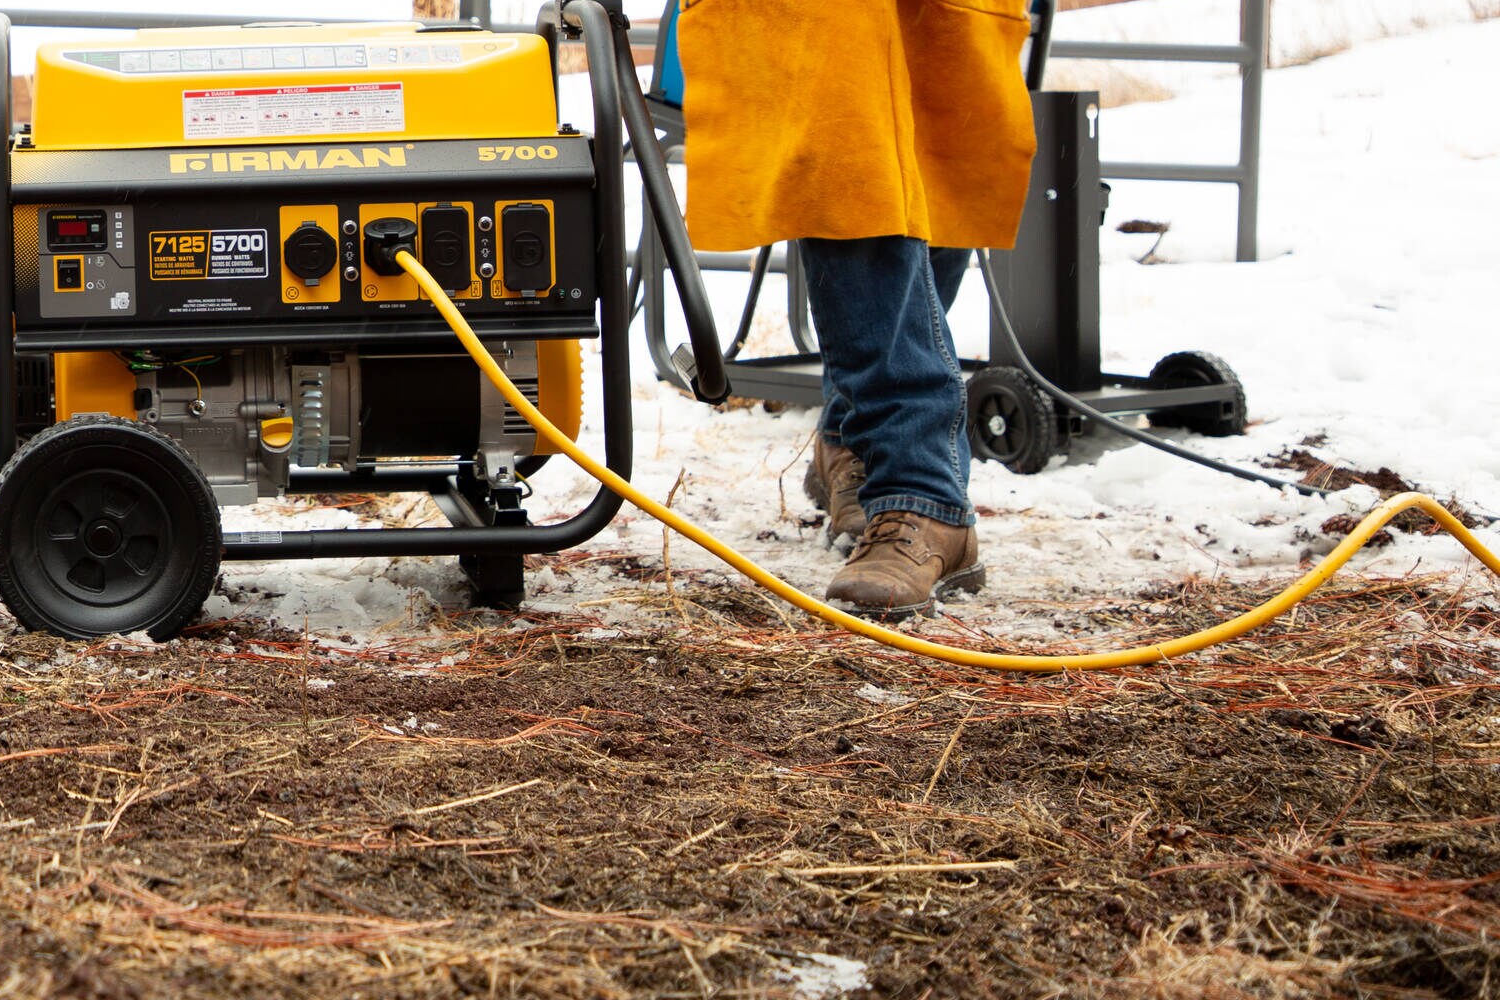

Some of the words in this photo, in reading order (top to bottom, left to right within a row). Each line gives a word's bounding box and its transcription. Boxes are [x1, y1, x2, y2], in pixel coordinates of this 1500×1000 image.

[169, 147, 407, 173] FIRMAN
[478, 145, 558, 162] 5700
[154, 236, 206, 254] 7125
[211, 234, 264, 252] 5700
